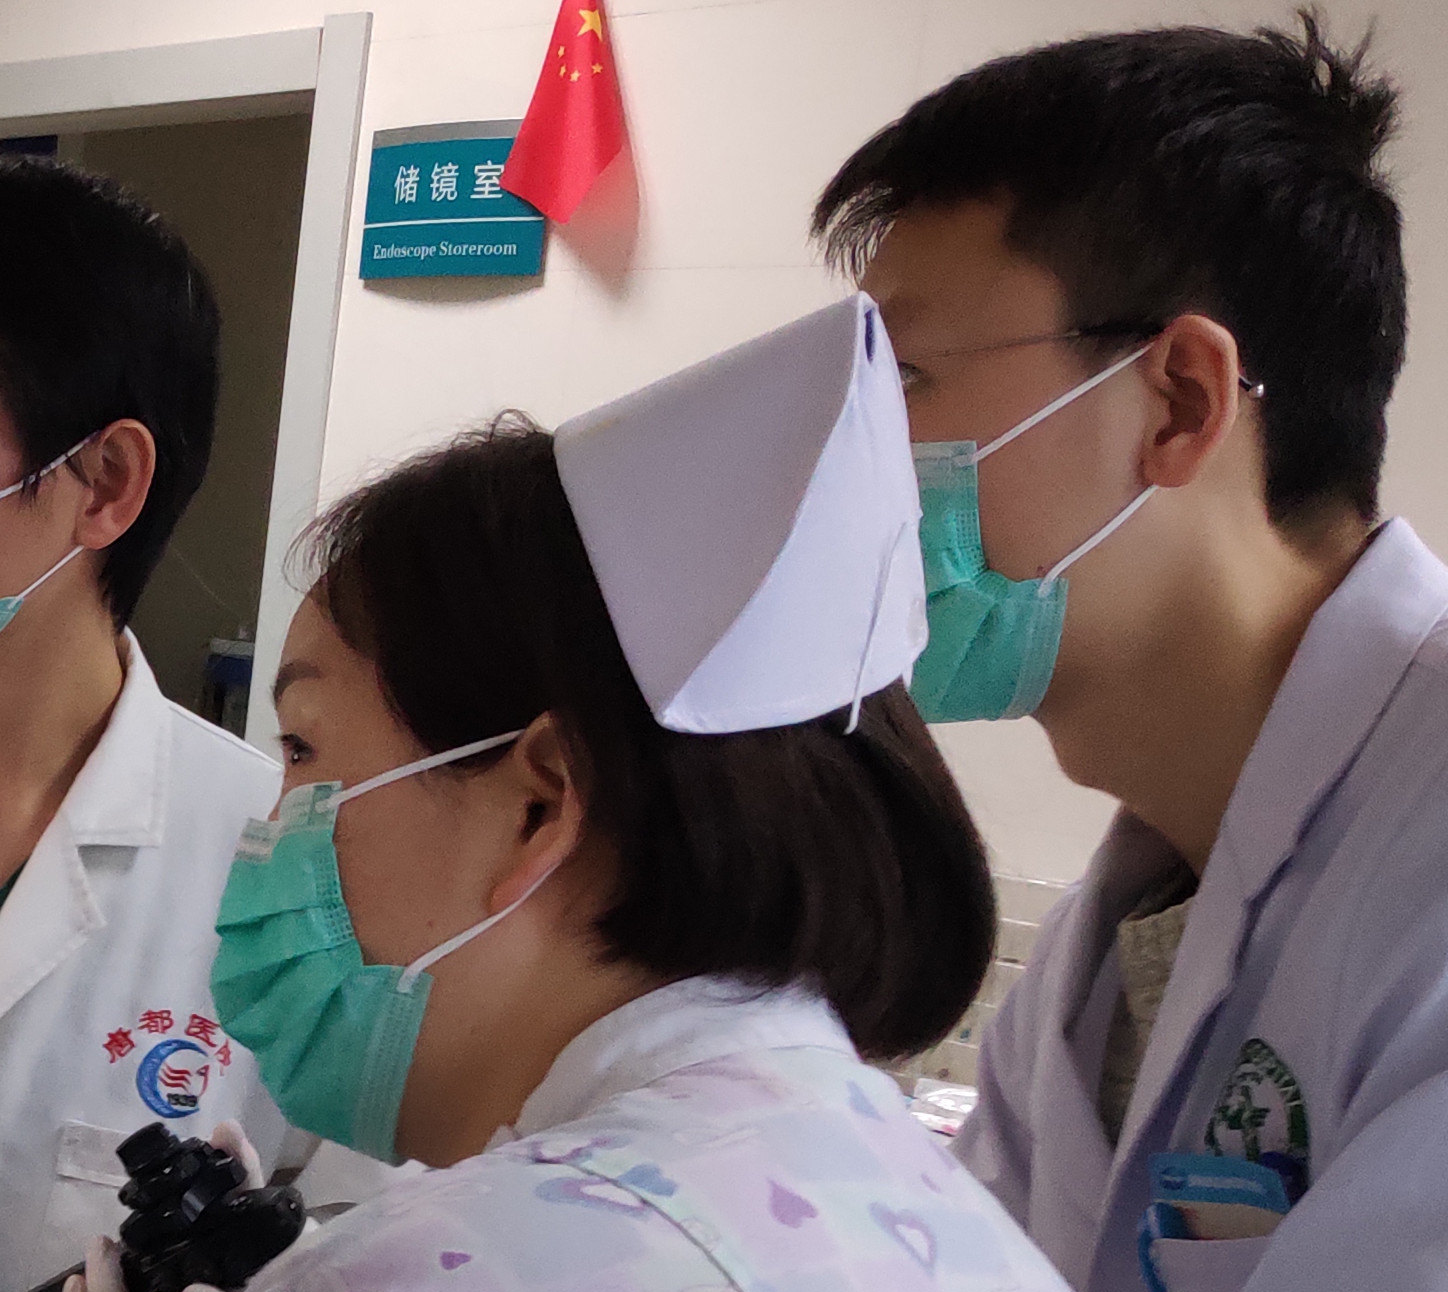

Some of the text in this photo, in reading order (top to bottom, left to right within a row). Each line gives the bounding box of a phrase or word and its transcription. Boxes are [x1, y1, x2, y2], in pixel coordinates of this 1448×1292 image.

[393, 159, 505, 204] 储镜室
[372, 240, 518, 260] Endoscope Storeroom
